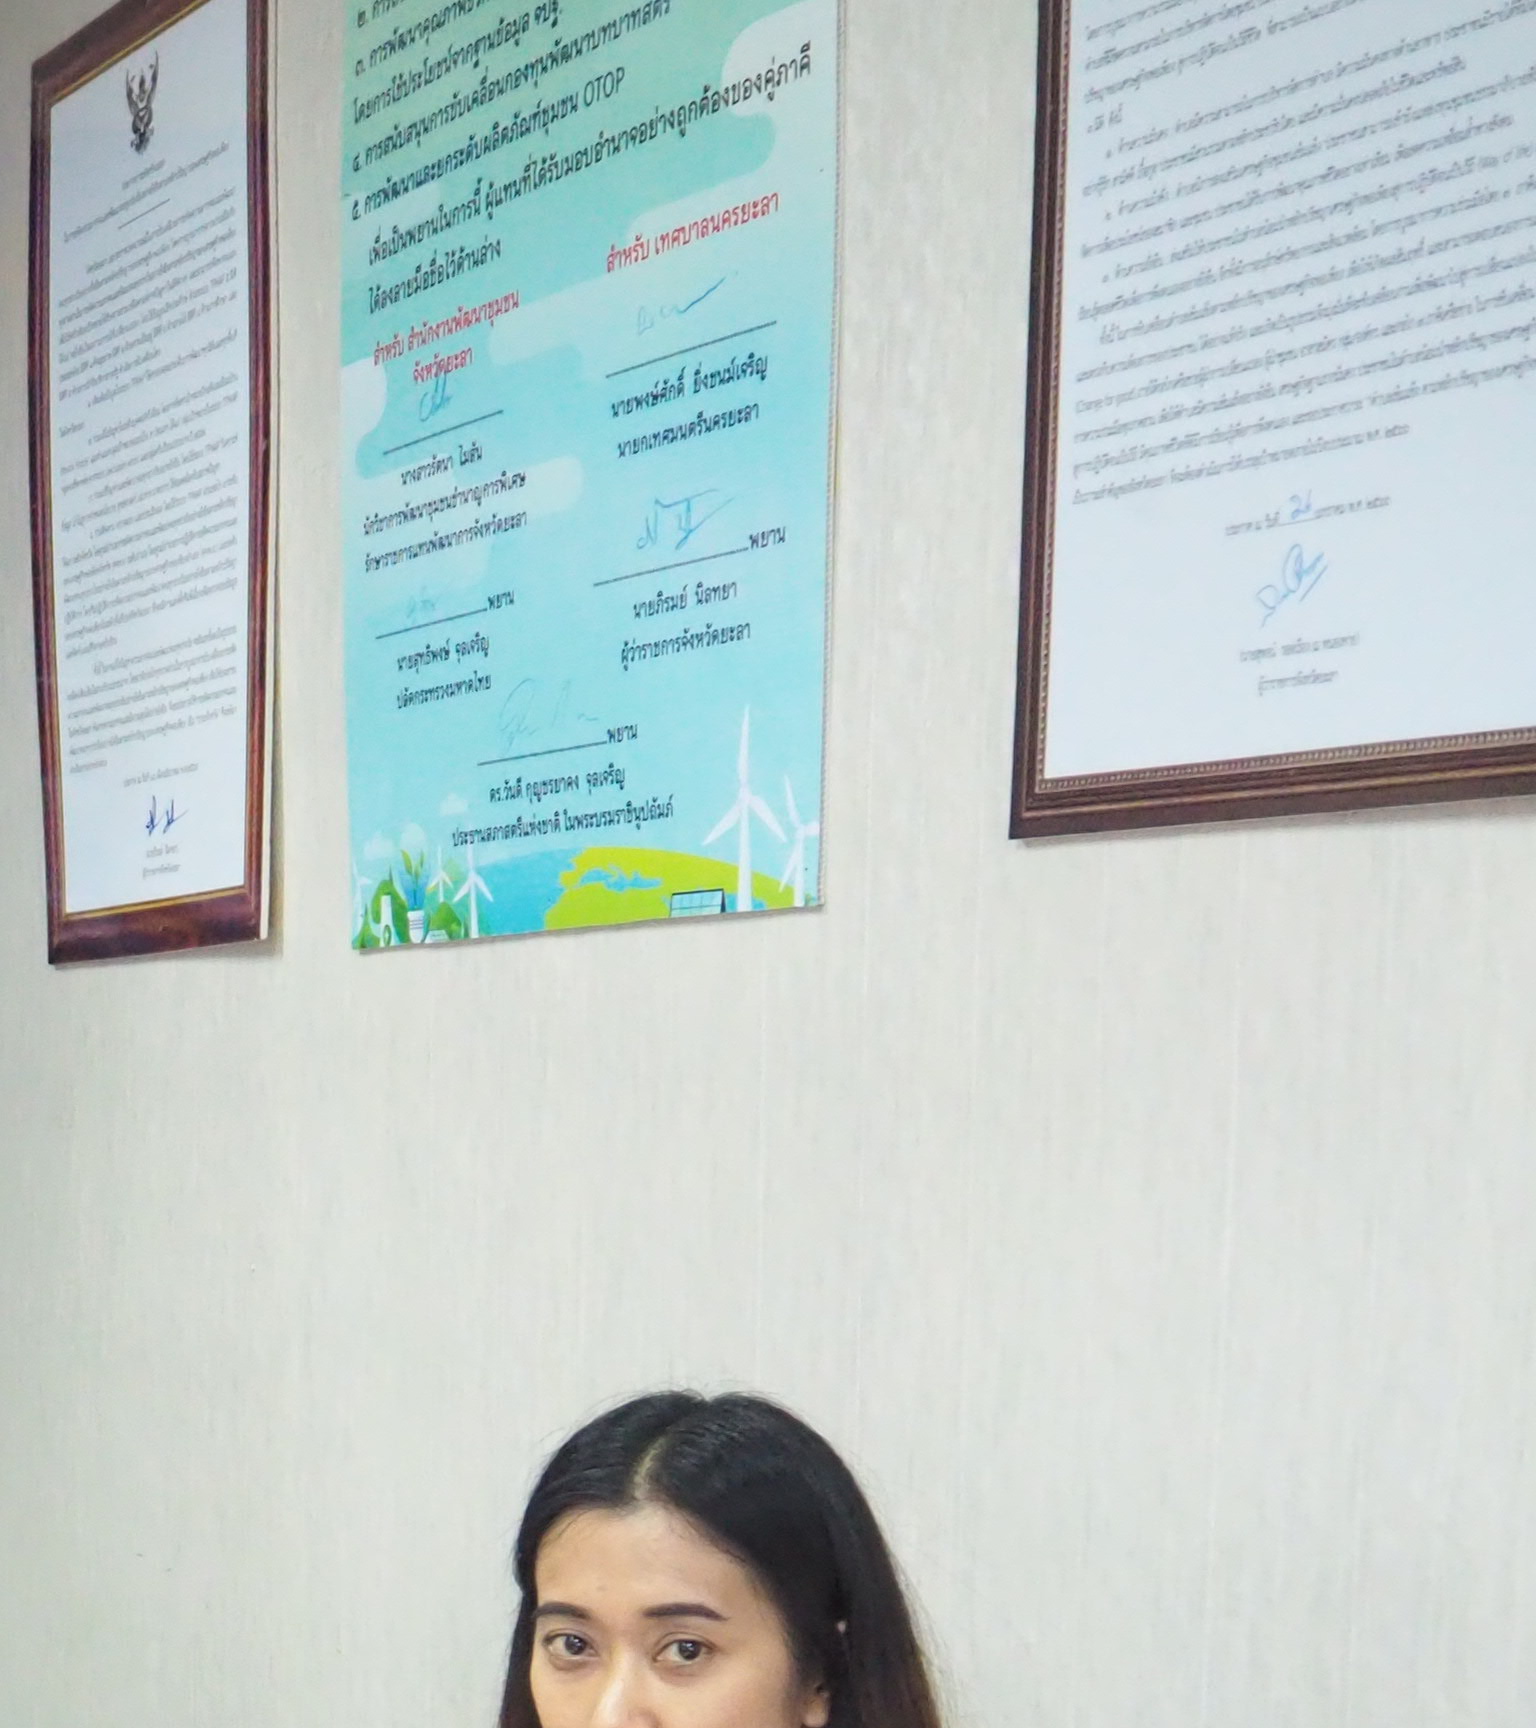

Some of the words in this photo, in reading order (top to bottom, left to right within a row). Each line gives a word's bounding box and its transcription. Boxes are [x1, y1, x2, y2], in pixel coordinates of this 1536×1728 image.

[582, 66, 627, 112] OTOP
[606, 236, 651, 274] สำหรับ
[654, 191, 780, 257] เทศบาลนครยะลา
[373, 328, 406, 366] สำหรับ
[407, 289, 521, 352] สำนักงานพัฒนาชุมชน
[412, 346, 474, 385] จังหวัดยะลา
[617, 401, 760, 459] นายกเทศมนตรีนครยะลา
[748, 526, 787, 551] พยาน
[487, 589, 516, 611] พยาน
[620, 620, 752, 673] ผู้ว่าราชการจังหวัดยะลา
[607, 722, 639, 744] พยาน
